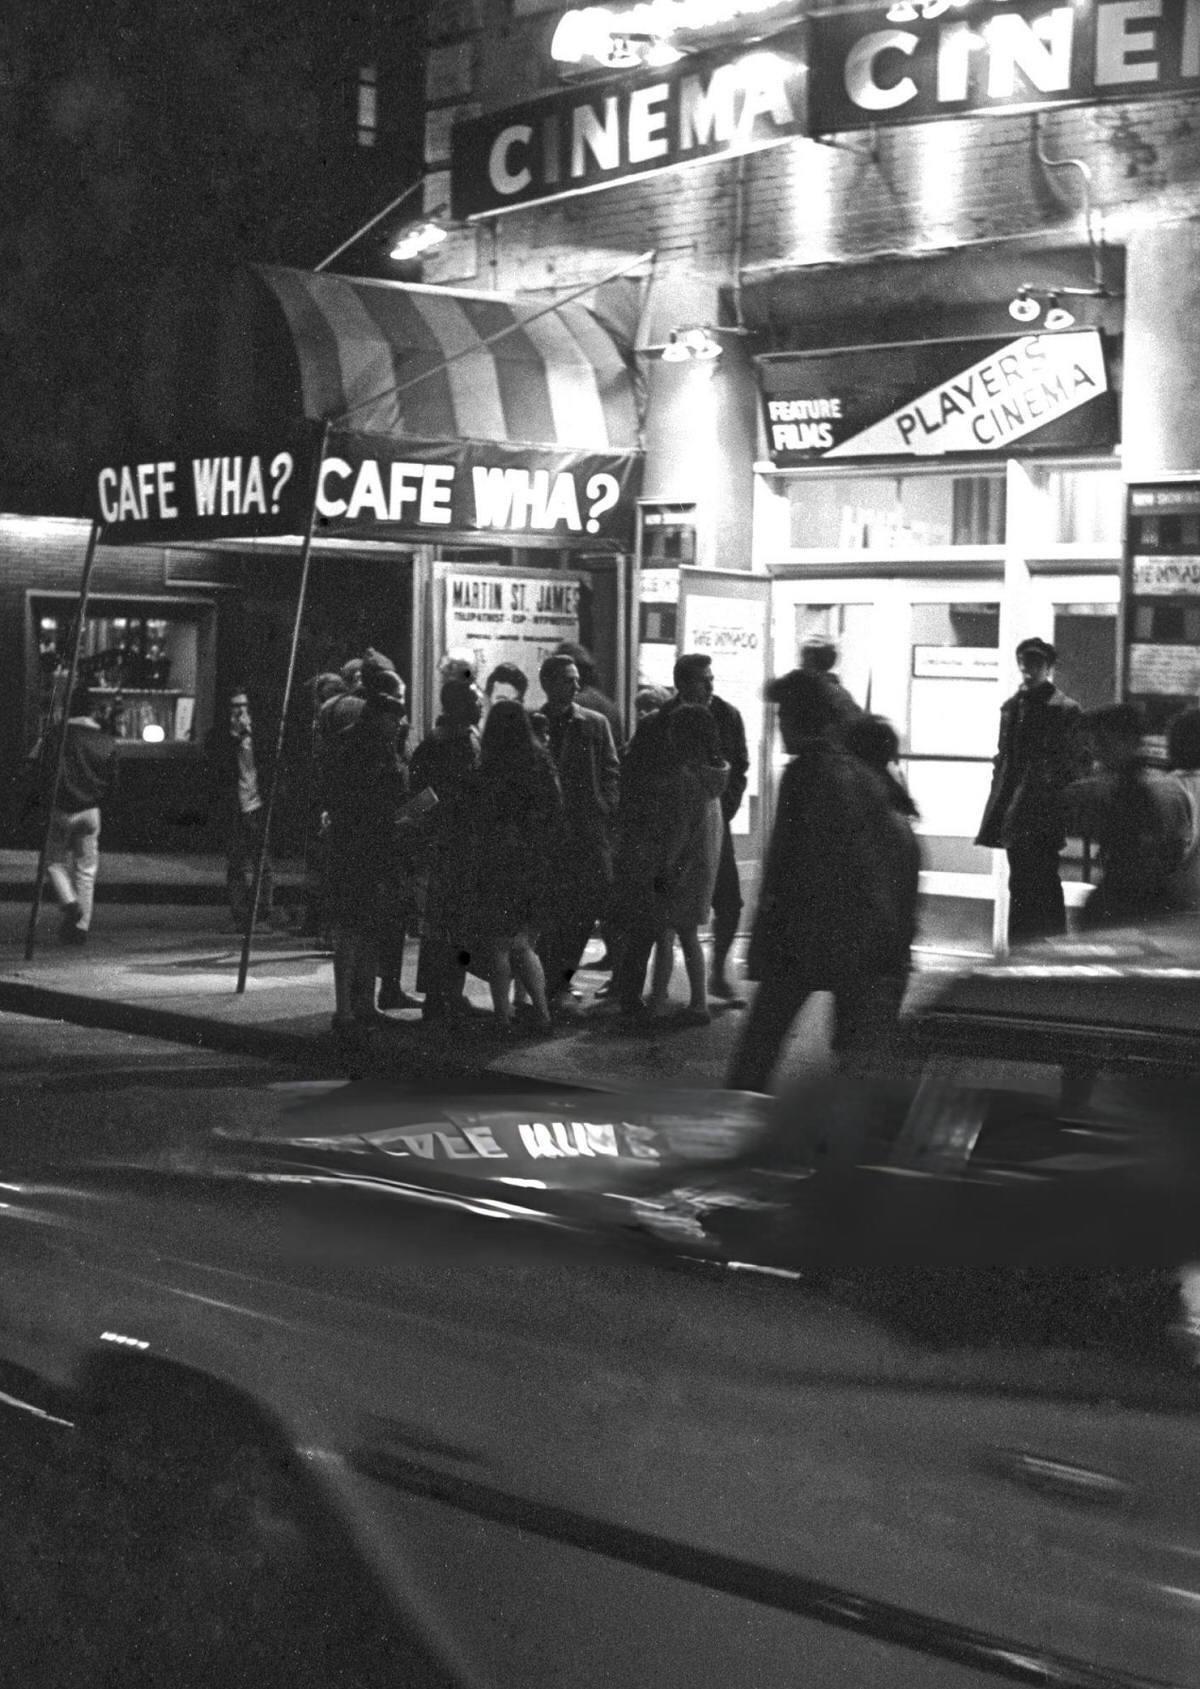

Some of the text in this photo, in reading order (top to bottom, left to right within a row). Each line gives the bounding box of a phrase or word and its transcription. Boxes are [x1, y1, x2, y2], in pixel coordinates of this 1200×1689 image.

[489, 52, 808, 195] CINEMA
[768, 398, 843, 422] FEATURE
[897, 332, 1048, 446] PLAYERS
[971, 363, 1096, 445] CINEMA
[772, 423, 833, 450] FILMS
[98, 451, 293, 523] CAFE WHA?
[314, 457, 620, 534] CAFE WHA?
[453, 581, 502, 610] MARTIN
